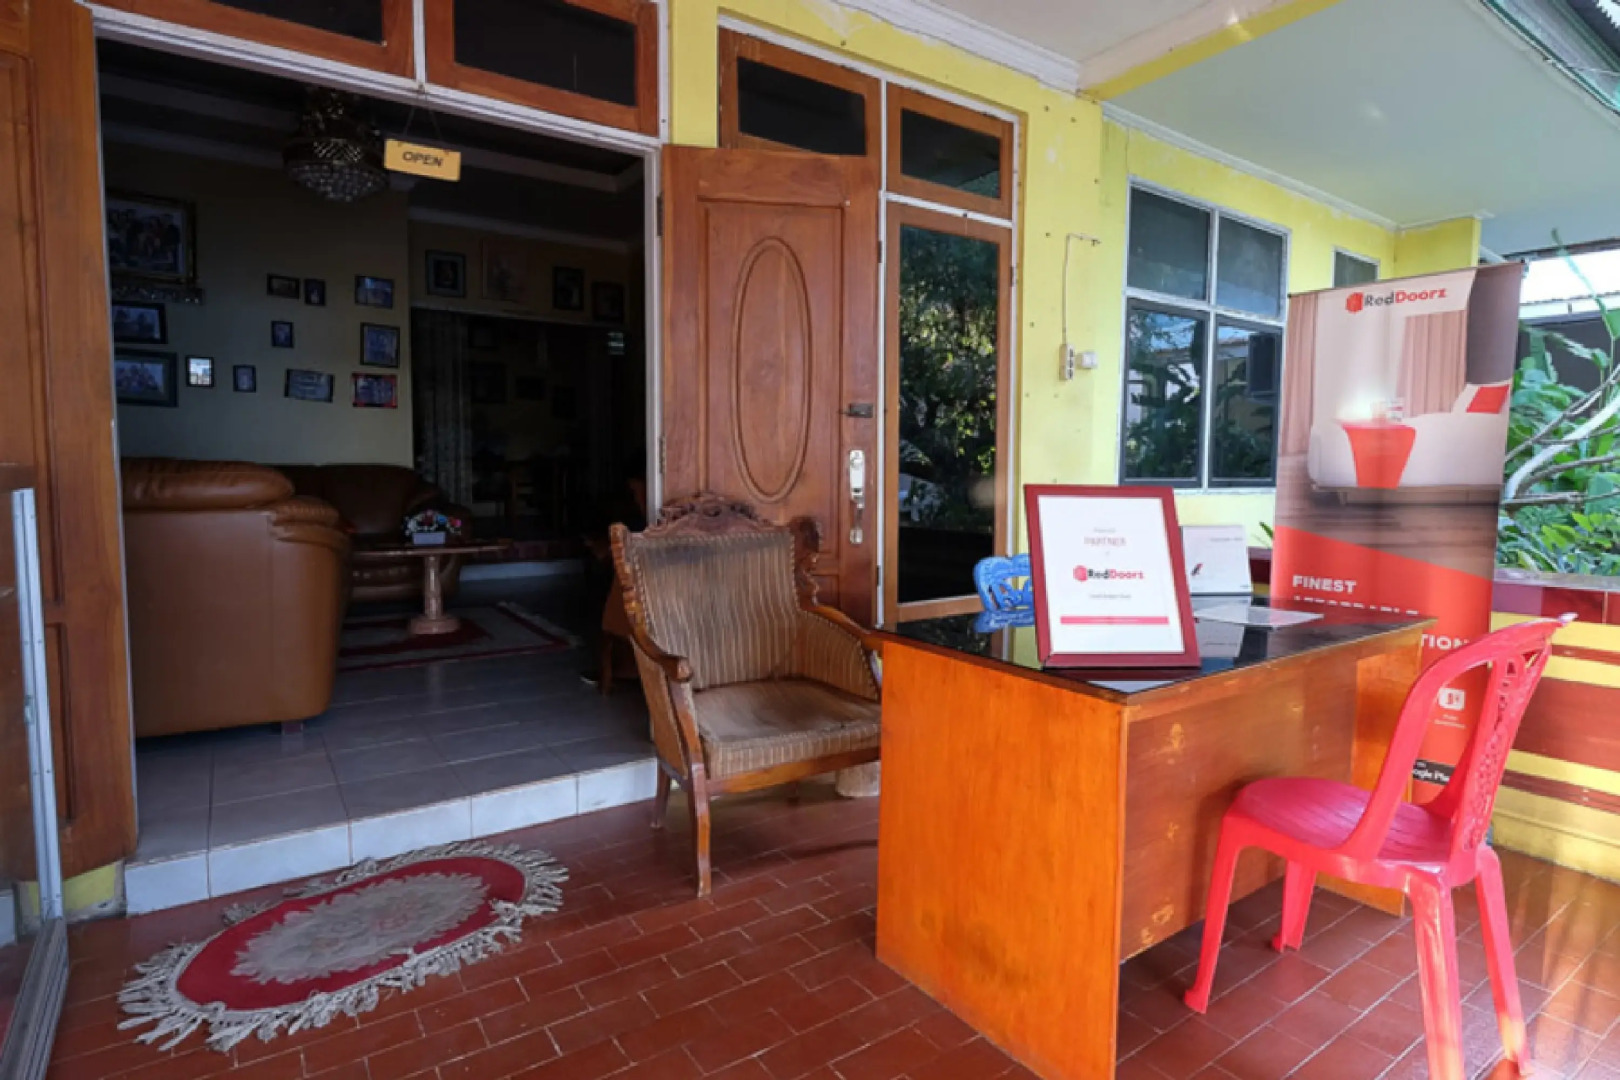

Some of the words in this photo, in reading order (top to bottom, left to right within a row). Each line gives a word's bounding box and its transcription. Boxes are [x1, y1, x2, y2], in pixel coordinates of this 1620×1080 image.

[402, 151, 444, 168] OPEN
[1364, 287, 1447, 307] RedDoorz
[1292, 575, 1357, 594] FINEST
